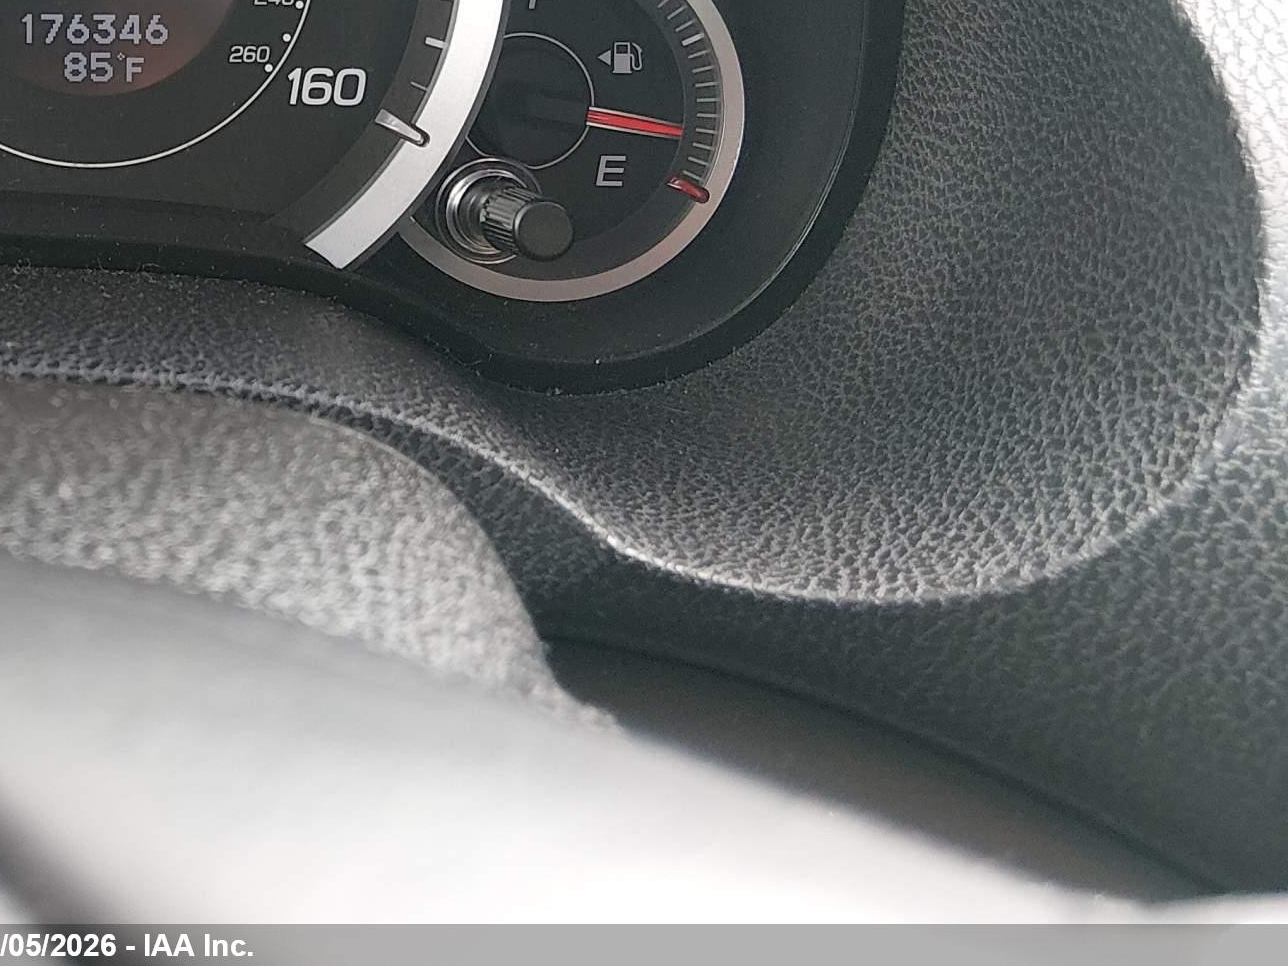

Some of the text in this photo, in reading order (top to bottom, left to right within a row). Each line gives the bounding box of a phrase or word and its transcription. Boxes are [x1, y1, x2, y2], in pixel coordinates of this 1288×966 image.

[21, 13, 169, 45] 176346
[228, 45, 270, 63] 260
[287, 67, 367, 106] 160
[595, 155, 627, 187] E
